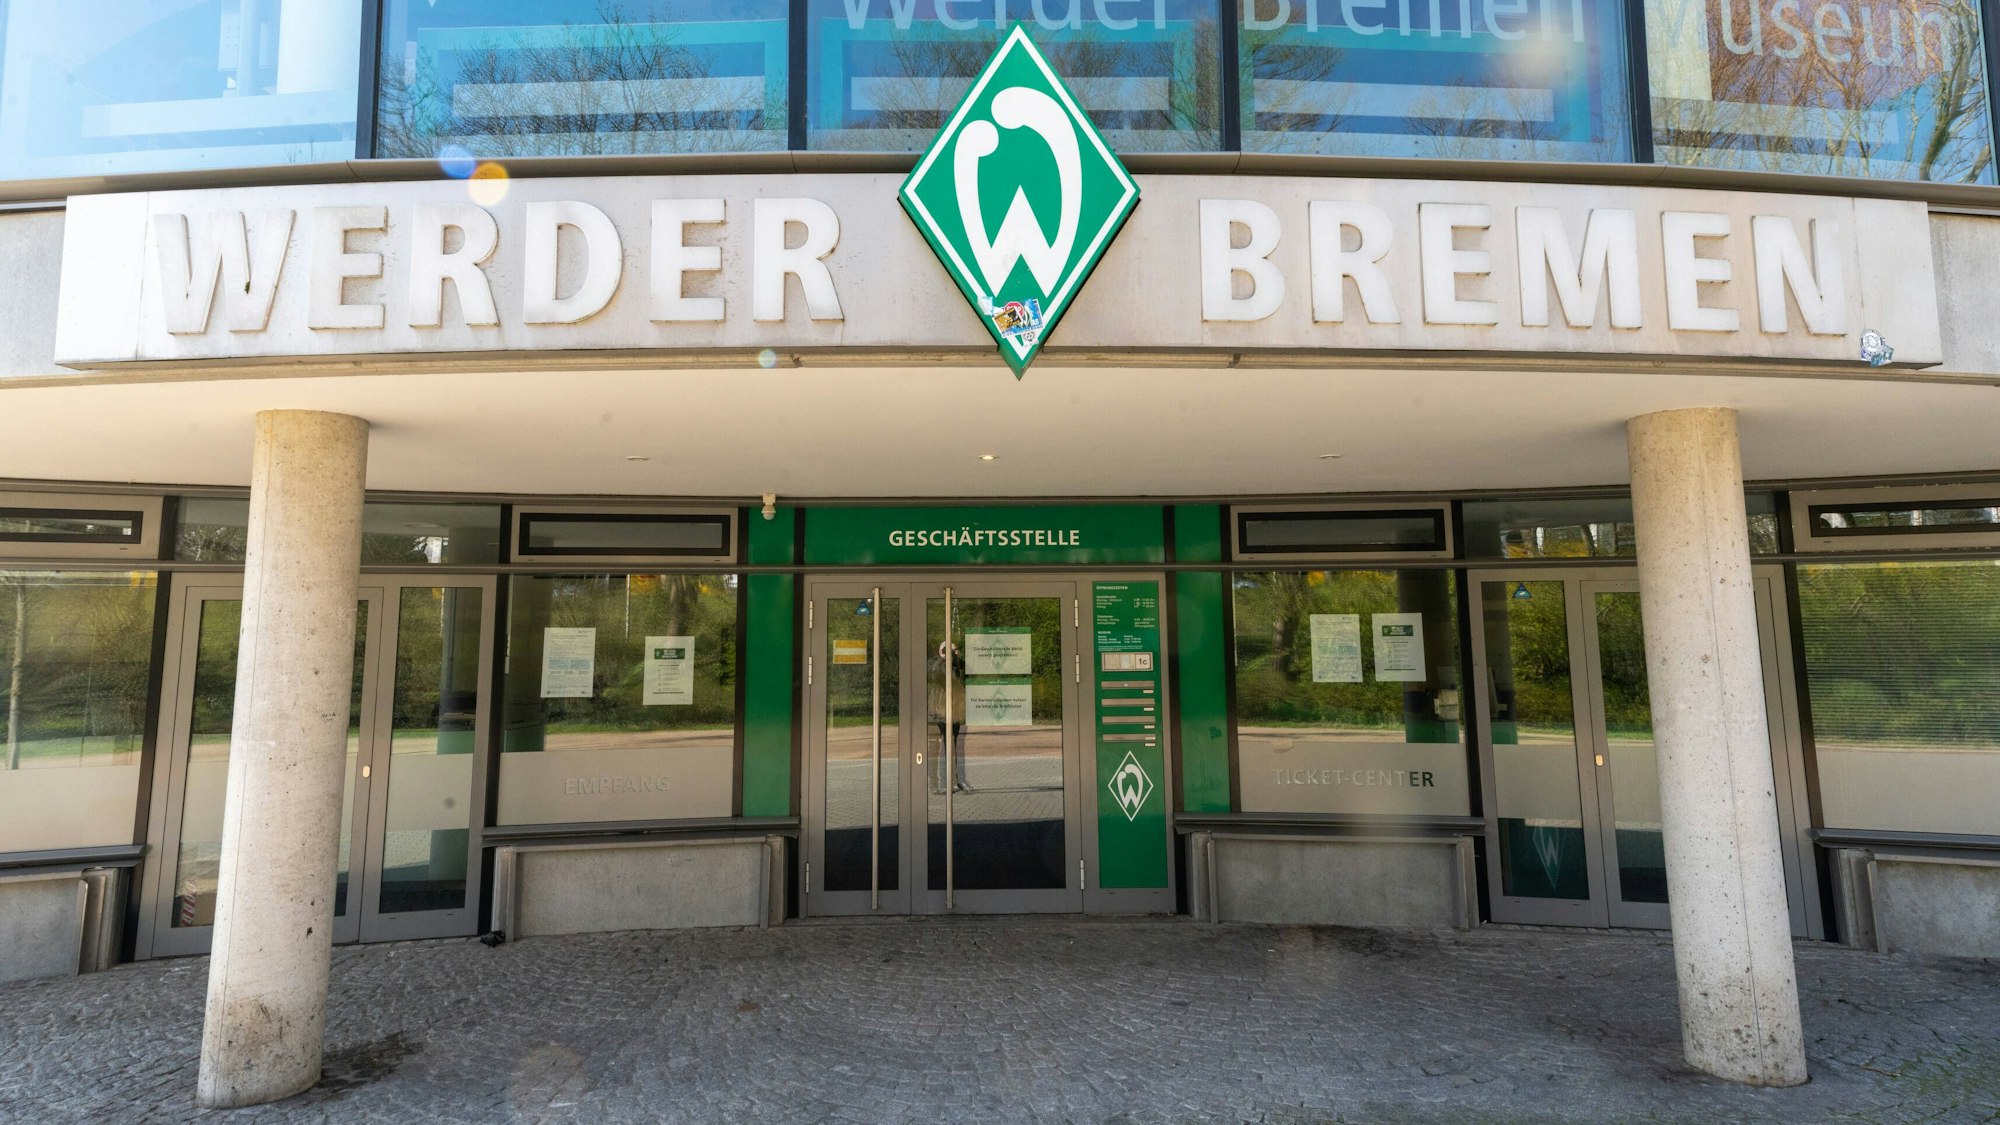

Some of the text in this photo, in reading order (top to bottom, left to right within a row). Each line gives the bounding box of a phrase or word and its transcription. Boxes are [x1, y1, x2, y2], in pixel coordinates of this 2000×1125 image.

[153, 198, 1848, 336] WERDER BREMEN
[888, 526, 1080, 546] GESCHÄFTSSTELLE
[563, 776, 671, 795] EMPFANG
[1273, 769, 1434, 787] TICKET-CENTER
